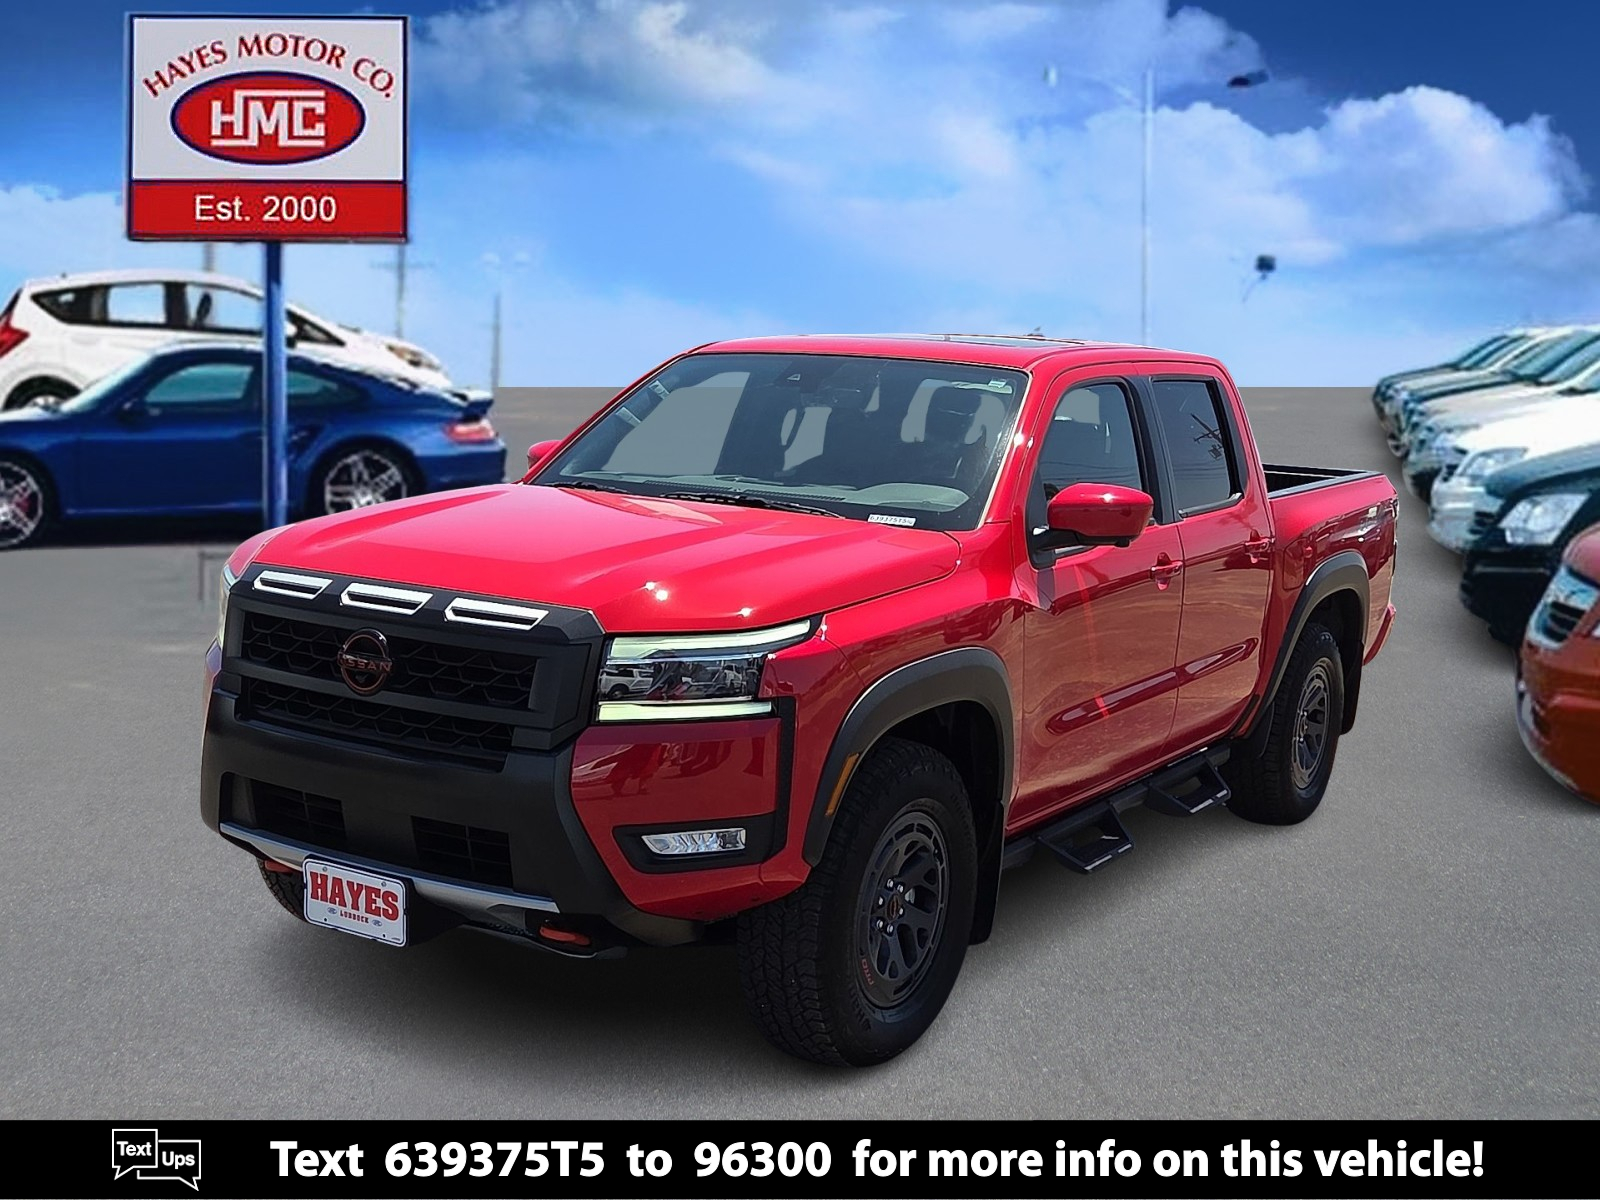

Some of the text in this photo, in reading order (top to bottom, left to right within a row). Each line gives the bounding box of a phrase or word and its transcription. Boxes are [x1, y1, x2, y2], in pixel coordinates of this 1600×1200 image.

[142, 33, 395, 98] HAYES MOTOR CO.
[210, 89, 326, 147] HMC
[194, 194, 336, 222] Est. 2000
[309, 871, 399, 922] HAYES
